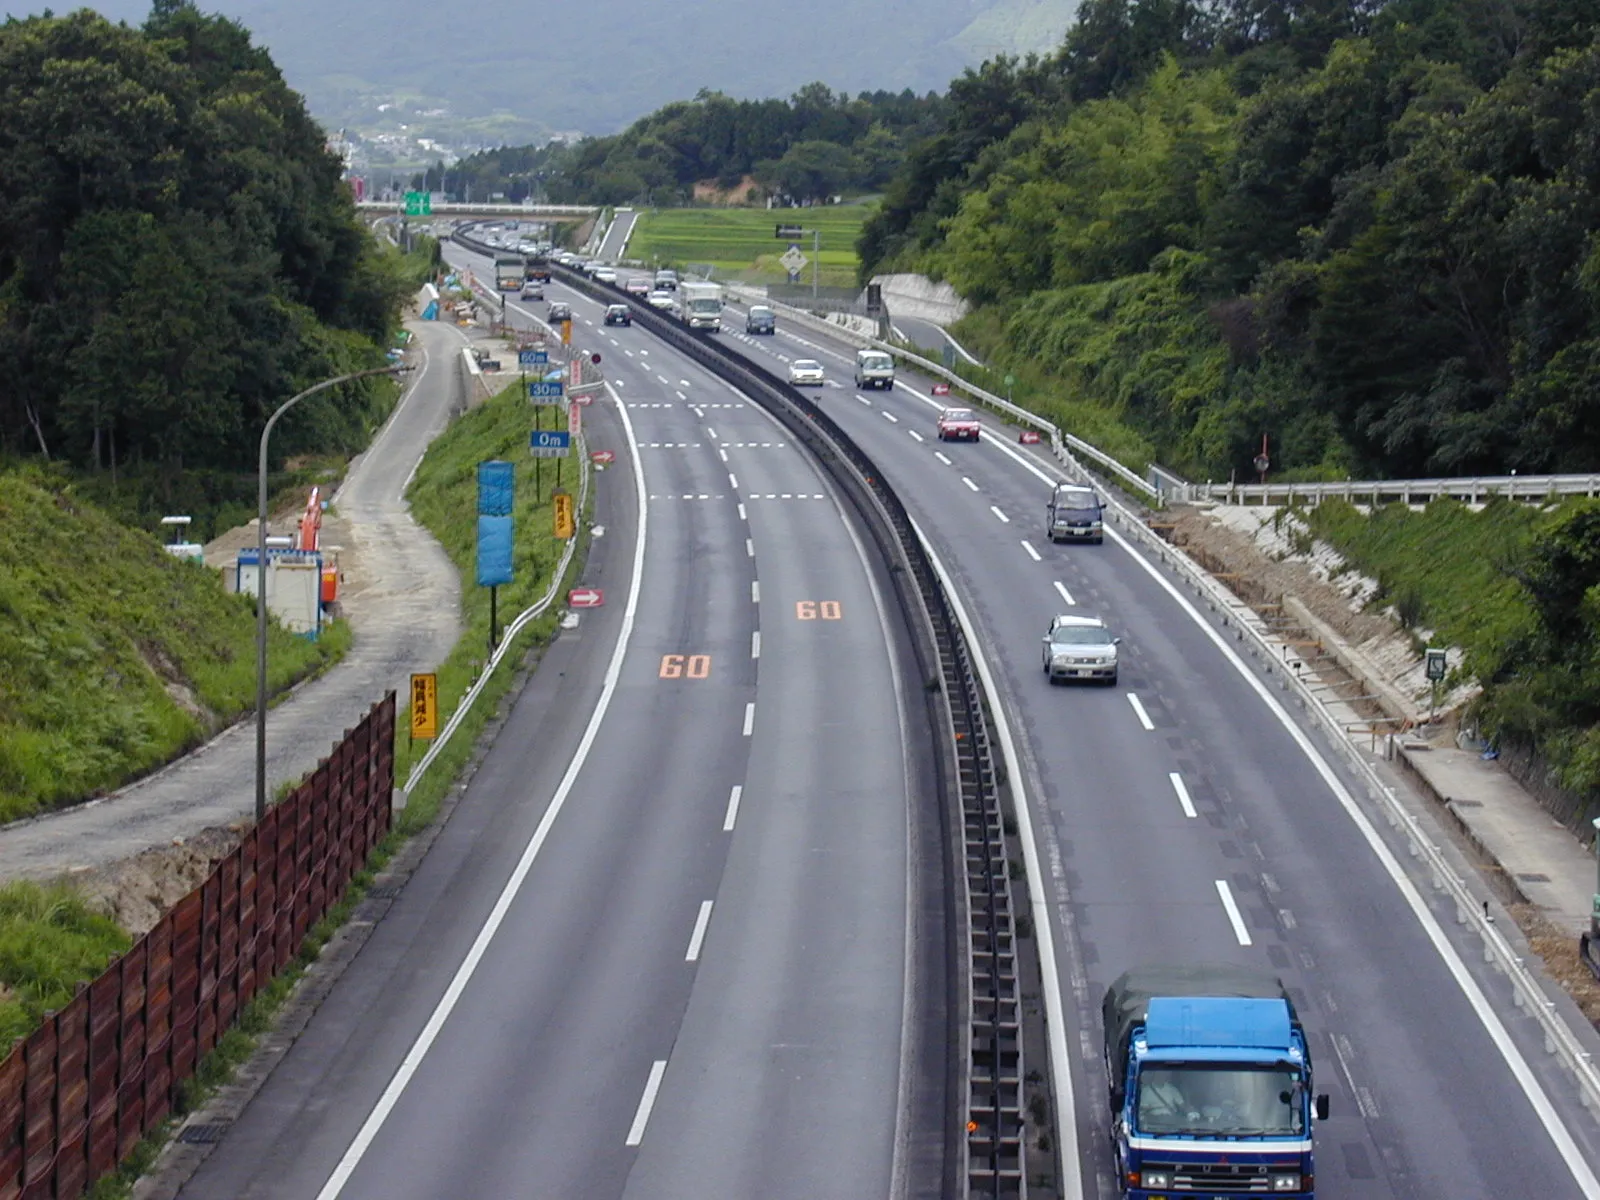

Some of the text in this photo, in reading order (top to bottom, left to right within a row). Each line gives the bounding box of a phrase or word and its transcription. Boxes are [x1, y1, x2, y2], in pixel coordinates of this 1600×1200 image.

[521, 352, 545, 363] 60m
[533, 383, 560, 396] 30m
[539, 432, 561, 446] 0m
[796, 600, 841, 620] 60
[659, 654, 711, 679] 60
